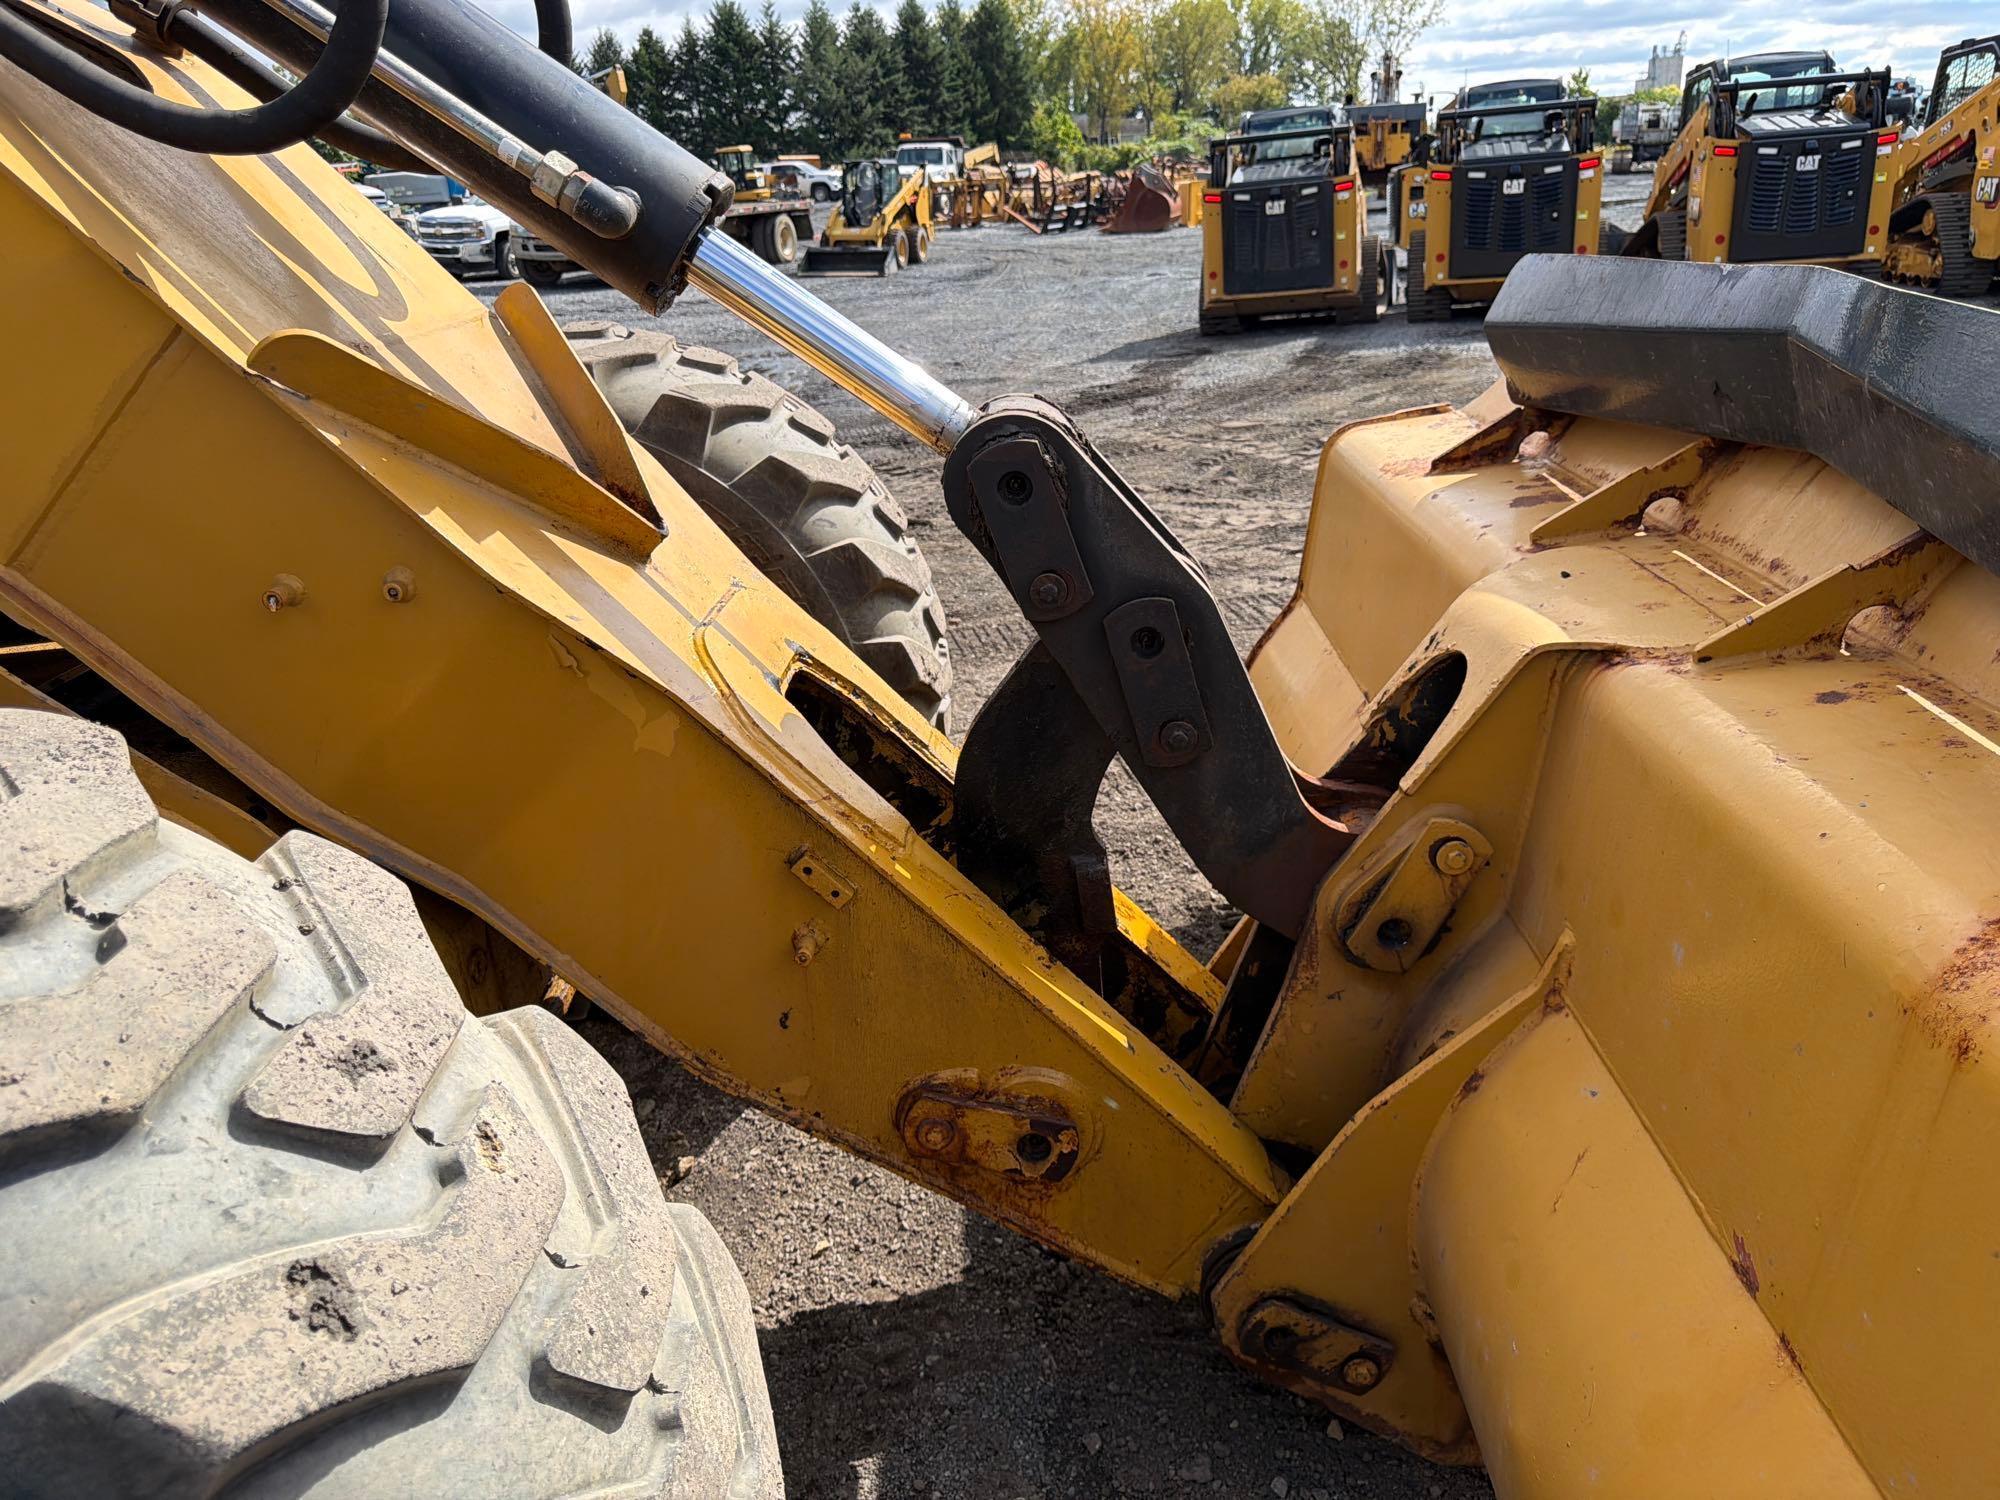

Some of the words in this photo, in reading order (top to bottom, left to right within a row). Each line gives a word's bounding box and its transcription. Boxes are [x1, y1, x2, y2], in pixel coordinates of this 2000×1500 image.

[1796, 155, 1821, 171] CAT
[1503, 178, 1526, 195] CAT
[1976, 176, 1999, 202] CAT
[1265, 200, 1286, 215] CAT
